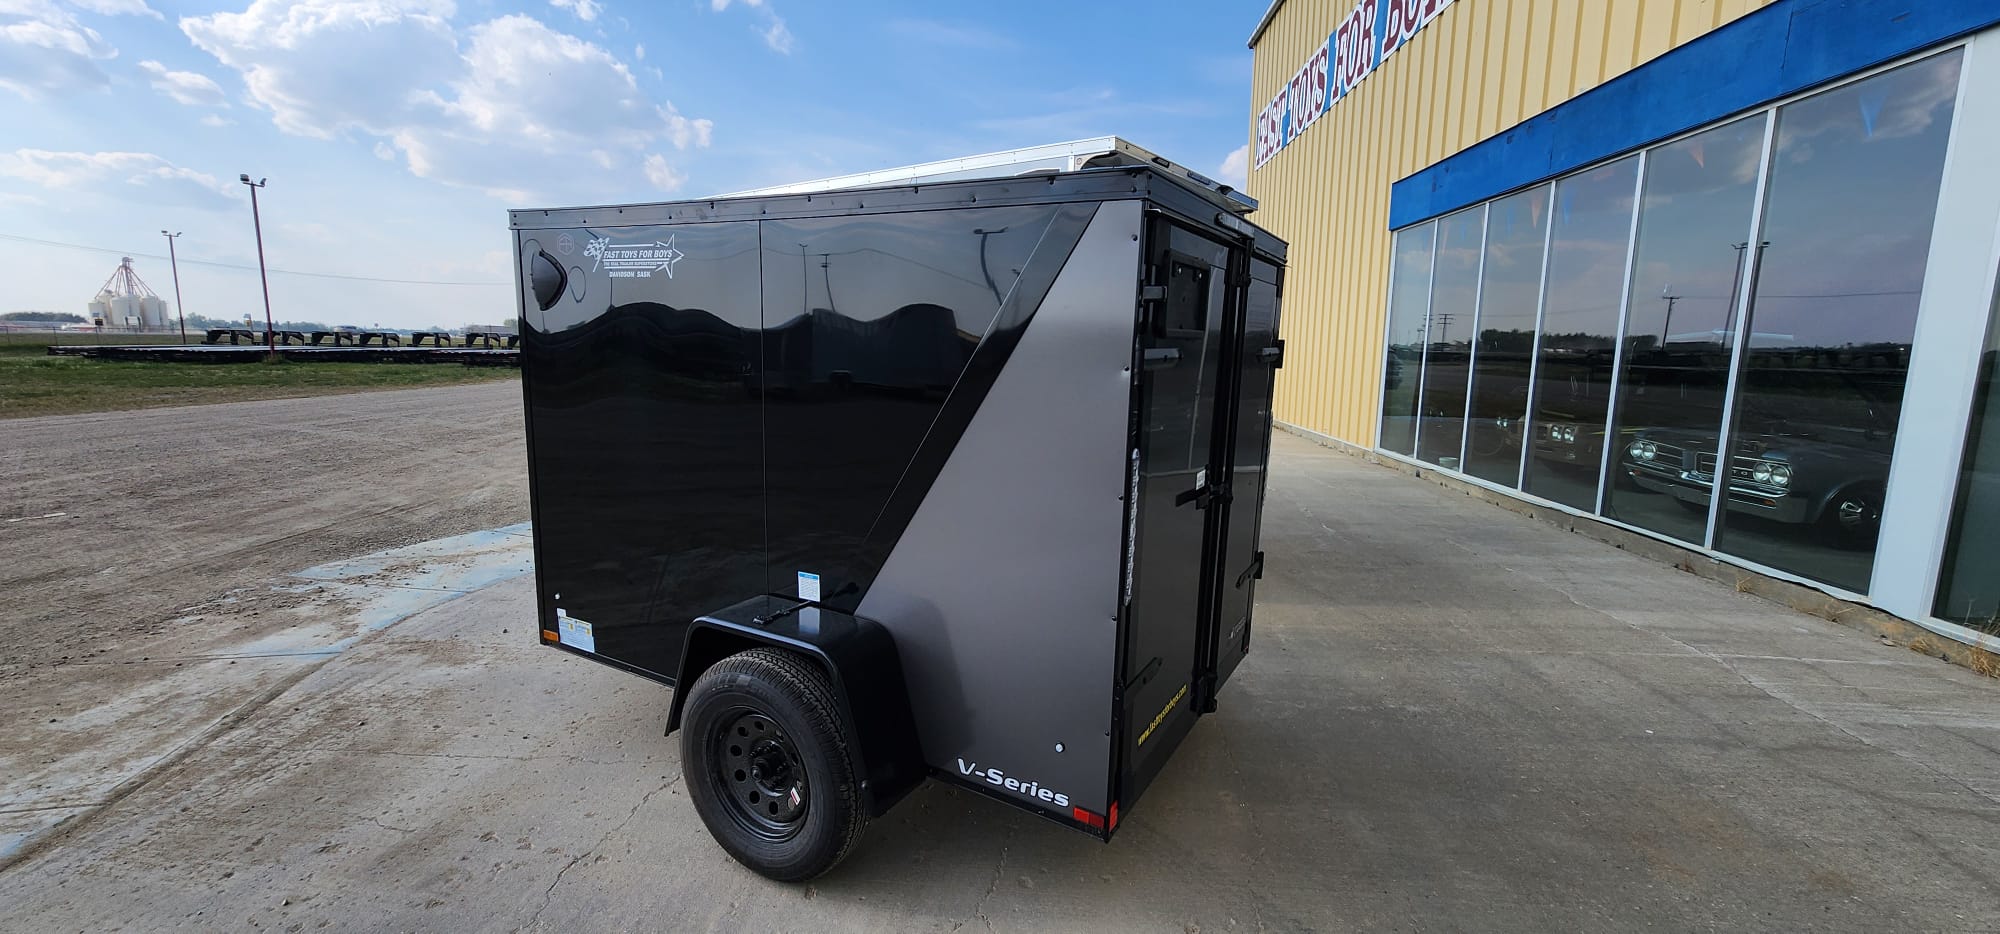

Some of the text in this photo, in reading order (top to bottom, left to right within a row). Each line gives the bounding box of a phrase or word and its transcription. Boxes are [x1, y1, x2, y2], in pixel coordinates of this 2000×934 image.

[1256, 89, 1287, 167] FAST
[1288, 46, 1328, 139] TOYS
[1332, 0, 1377, 100] FOR
[603, 249, 673, 259] FAST TOYS FOR BOYS
[957, 757, 1069, 808] V-Series
